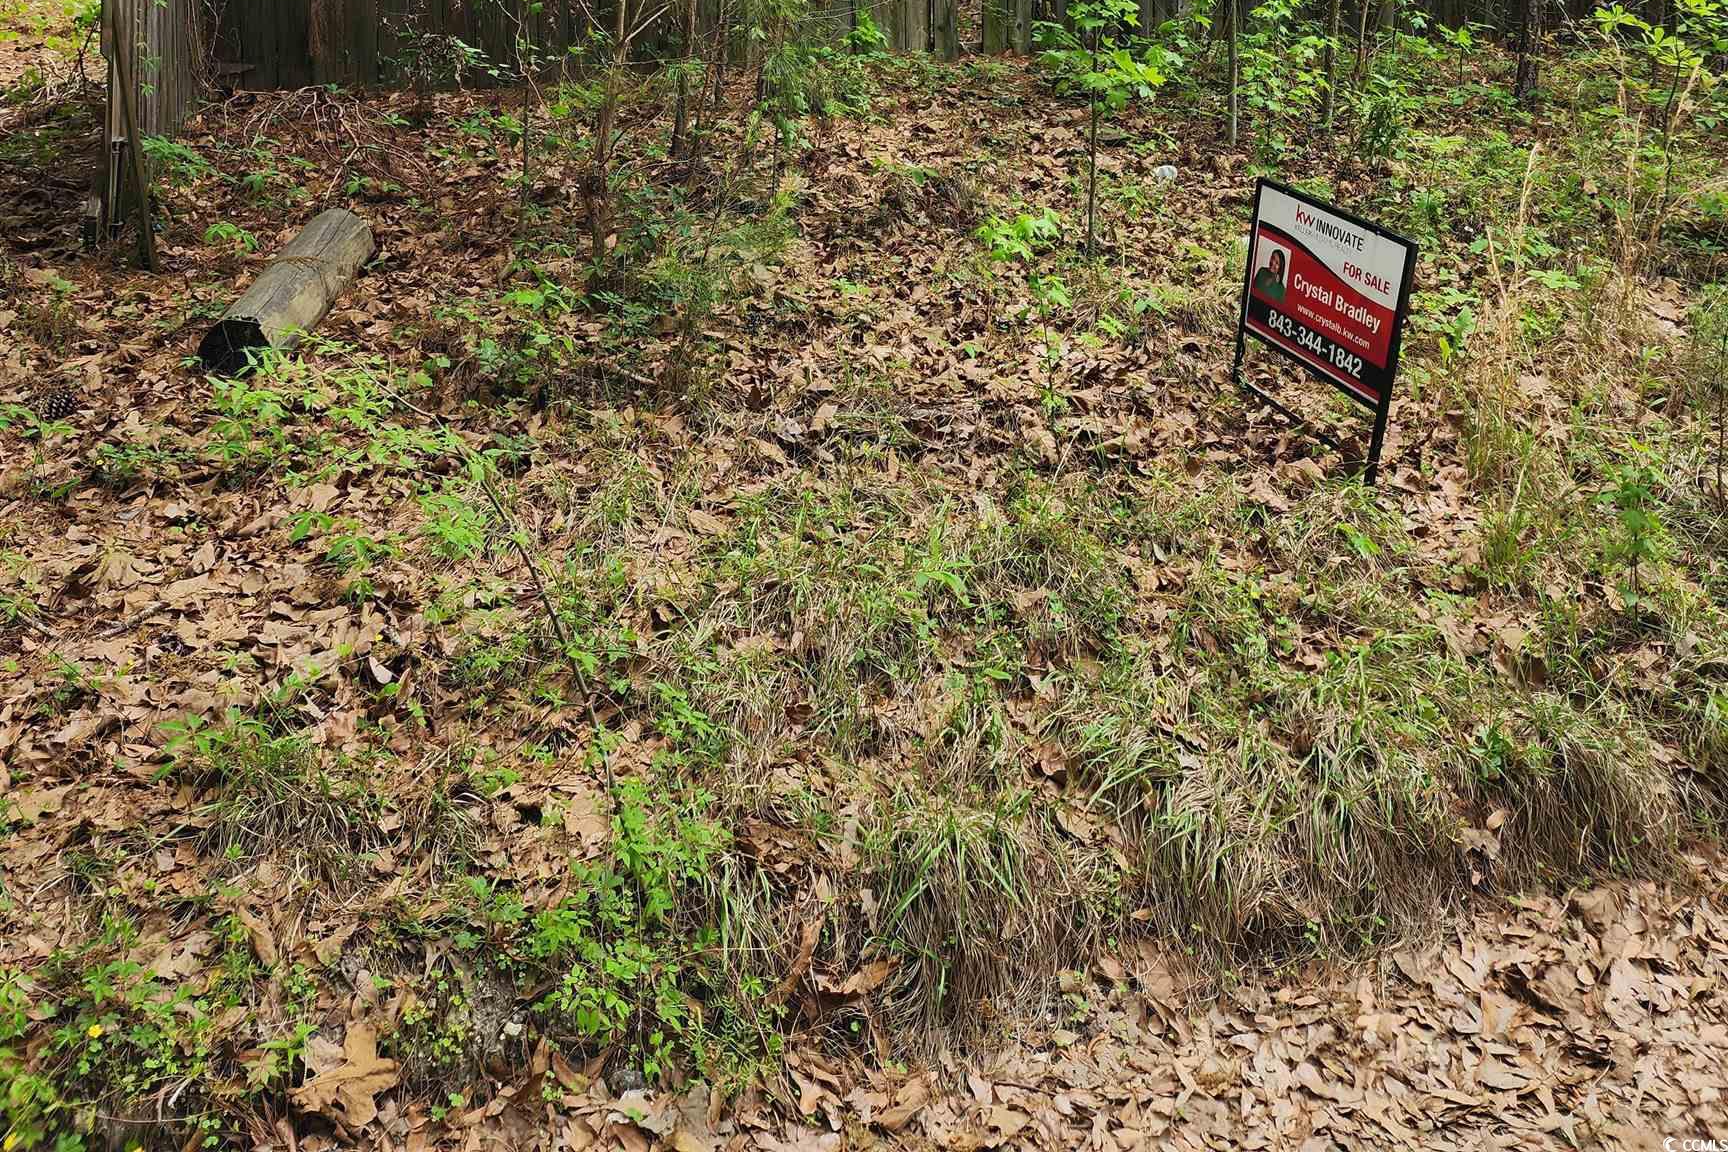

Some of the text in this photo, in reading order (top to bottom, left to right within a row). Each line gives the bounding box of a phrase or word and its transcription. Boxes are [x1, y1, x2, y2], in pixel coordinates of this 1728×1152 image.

[1315, 218, 1364, 252] INNOVATE
[1343, 261, 1391, 295] FOR SALE
[1294, 273, 1381, 334] Crystal Bradley
[1297, 303, 1370, 351] www.crystalb.kw.com
[1268, 310, 1362, 379] 843-344-1842
